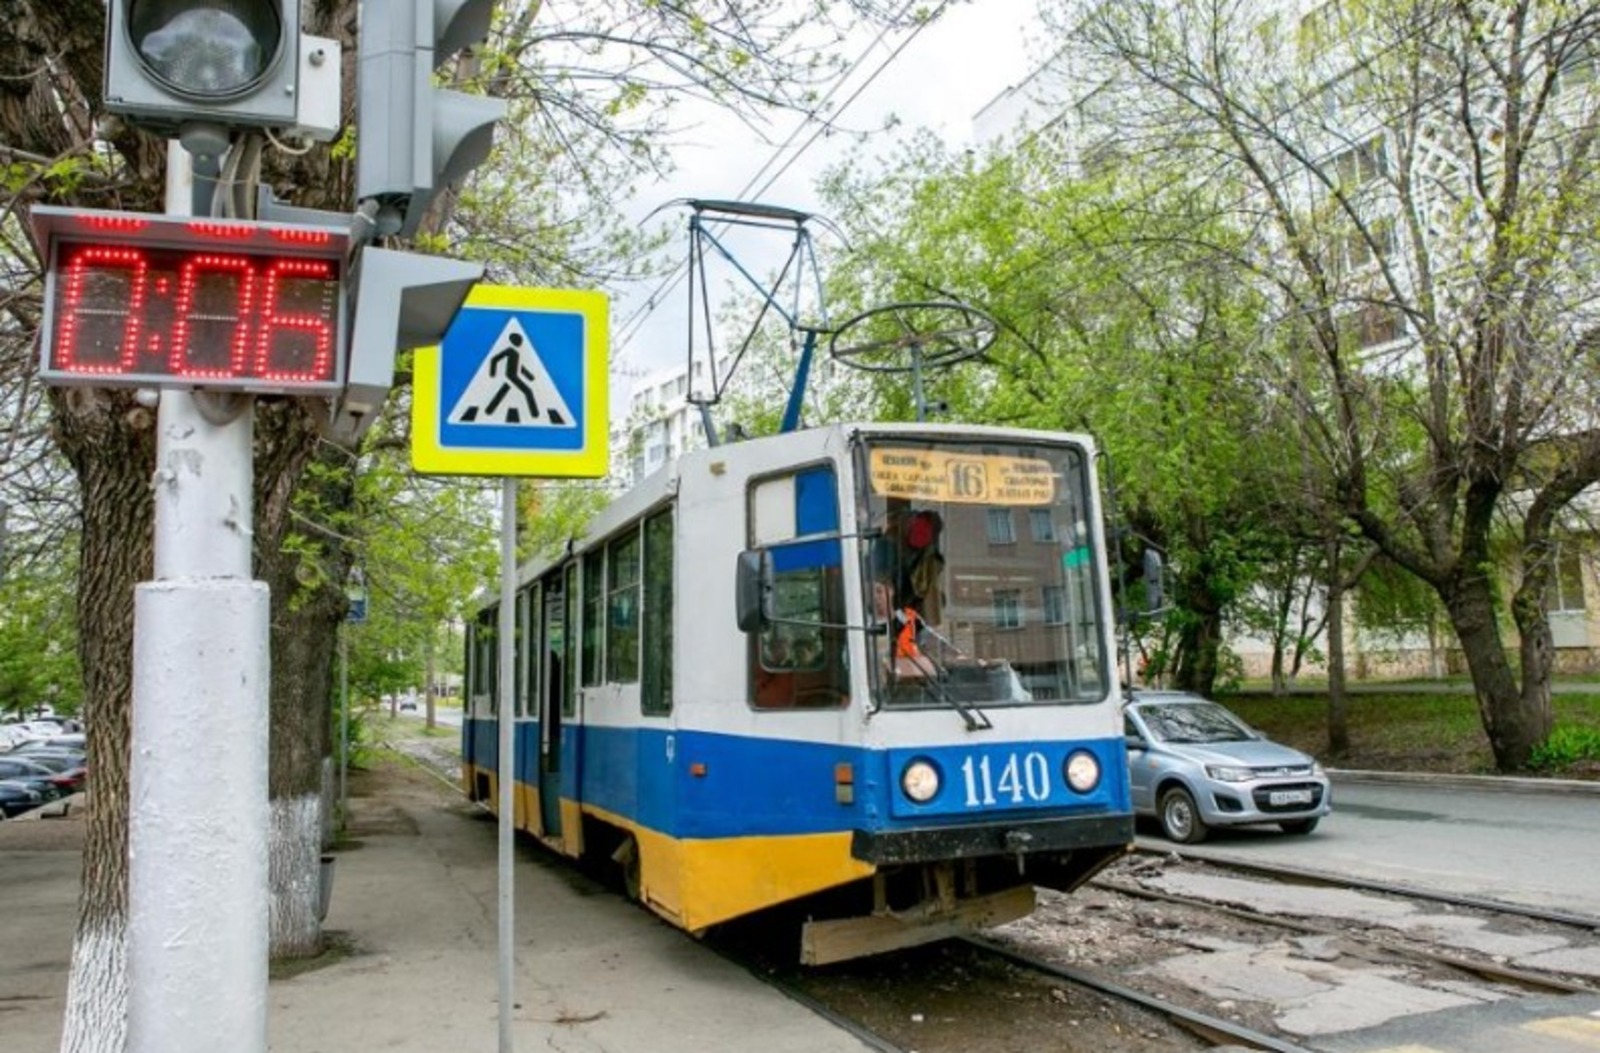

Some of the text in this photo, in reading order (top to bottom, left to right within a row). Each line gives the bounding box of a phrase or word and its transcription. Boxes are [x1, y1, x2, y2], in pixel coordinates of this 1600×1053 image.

[57, 248, 331, 382] 0:06
[952, 463, 983, 497] 16
[961, 752, 1050, 806] 1140
